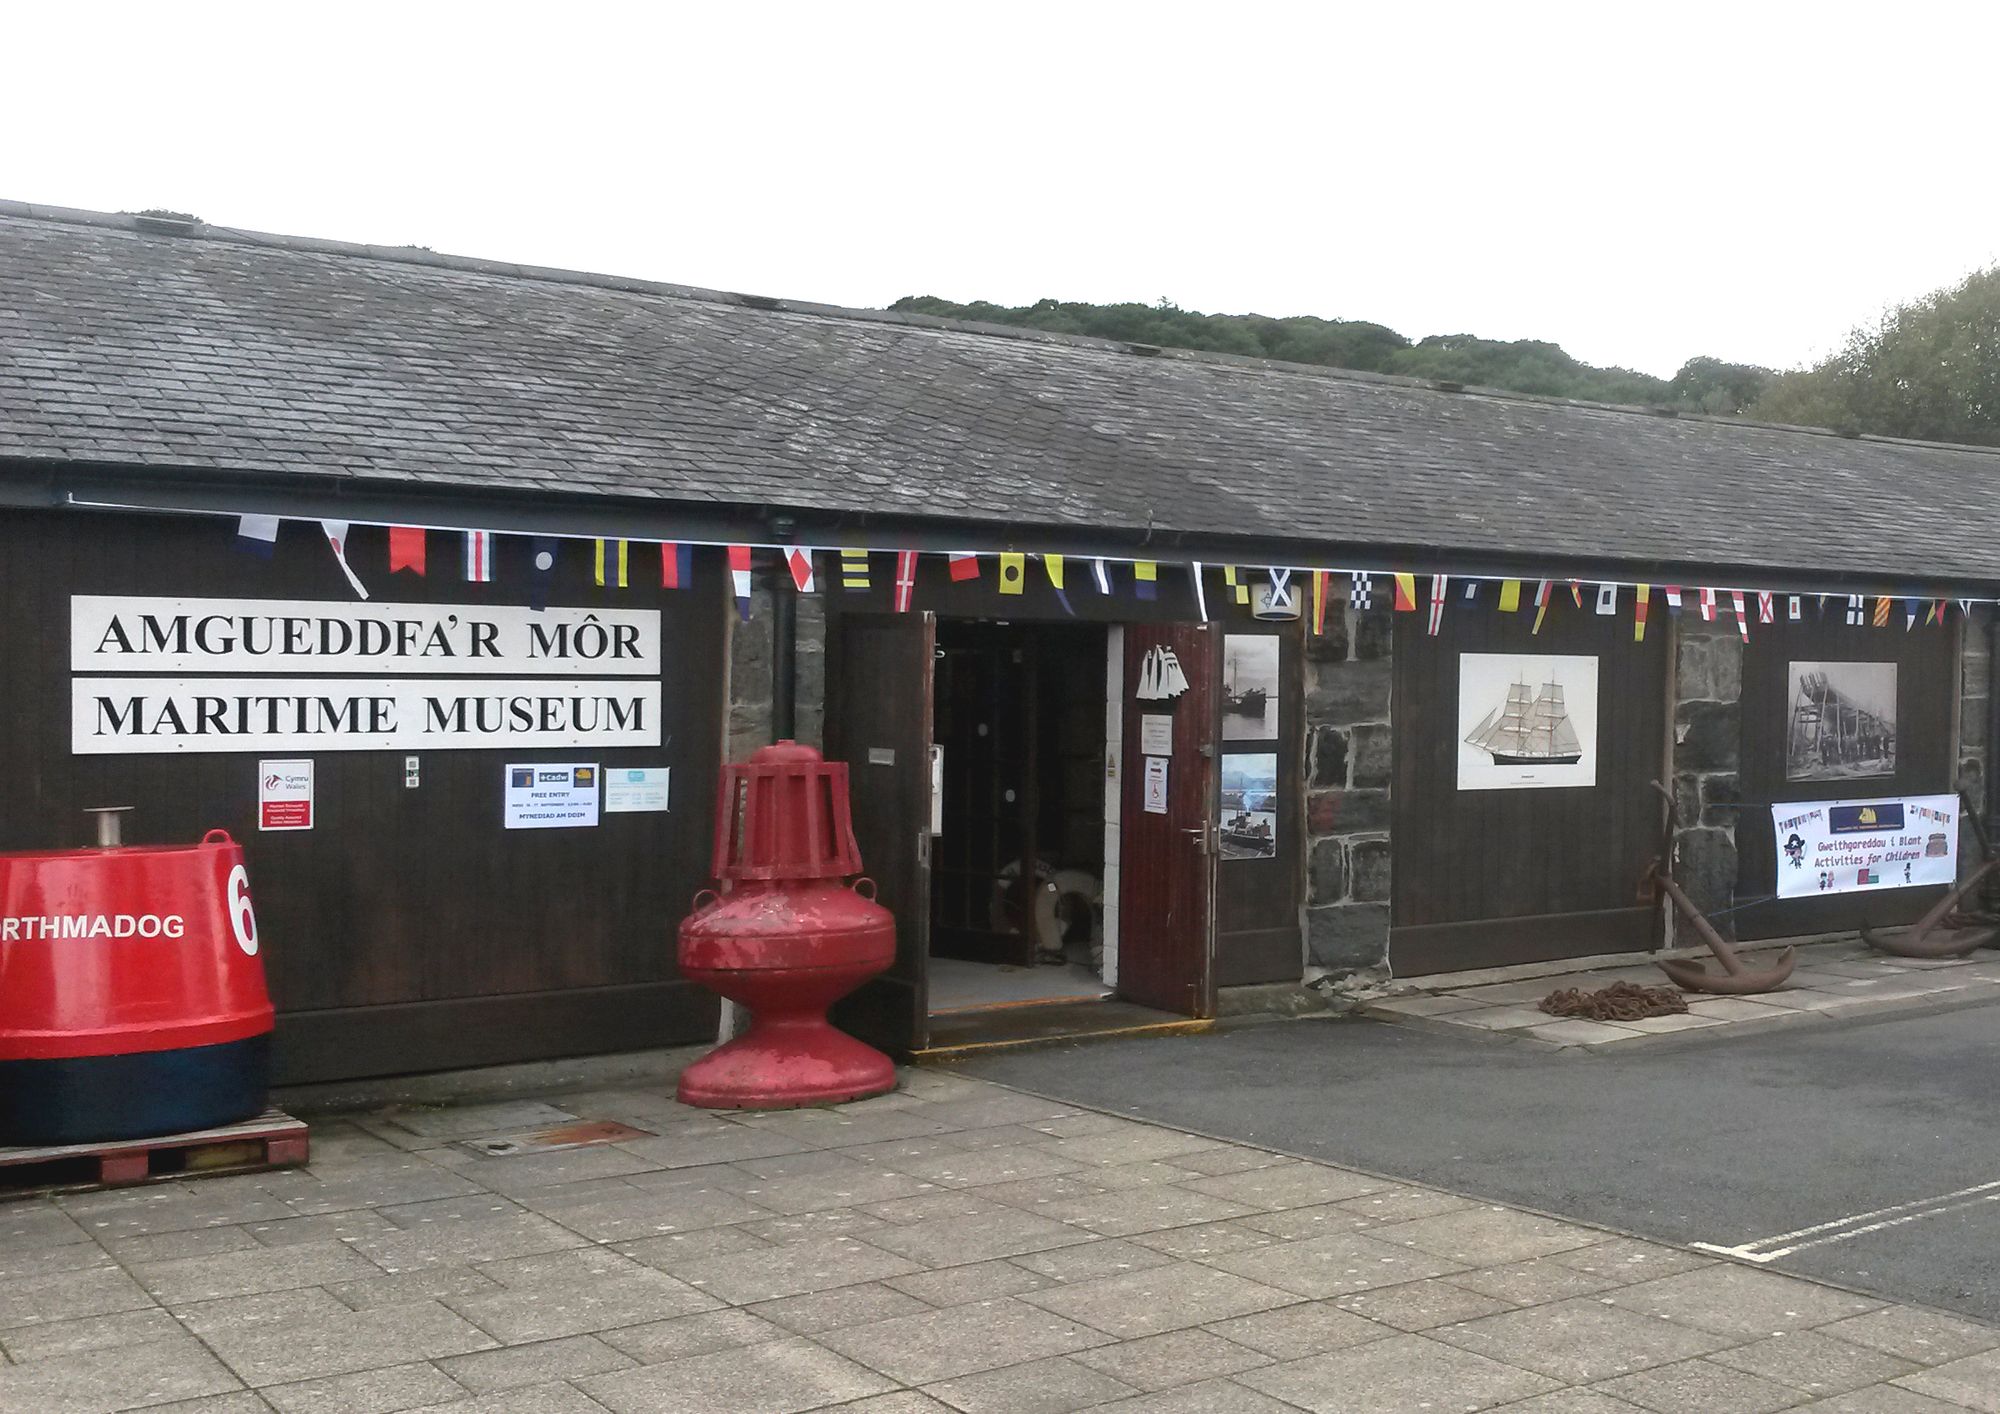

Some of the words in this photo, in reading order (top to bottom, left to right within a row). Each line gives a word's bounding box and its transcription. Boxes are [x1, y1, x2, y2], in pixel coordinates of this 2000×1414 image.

[526, 613, 645, 659] MÔR
[92, 696, 398, 735] MARITIME
[422, 696, 647, 733] MUSEUM
[285, 775, 309, 784] Cymru
[1817, 838, 1886, 853] Gweithgareddau
[1899, 835, 1922, 846] Blant
[1814, 855, 1864, 868] Activities
[1866, 853, 1882, 866] for
[1885, 850, 1921, 862] Children
[227, 864, 259, 956] 6
[0, 914, 185, 941] RTHMADOG
